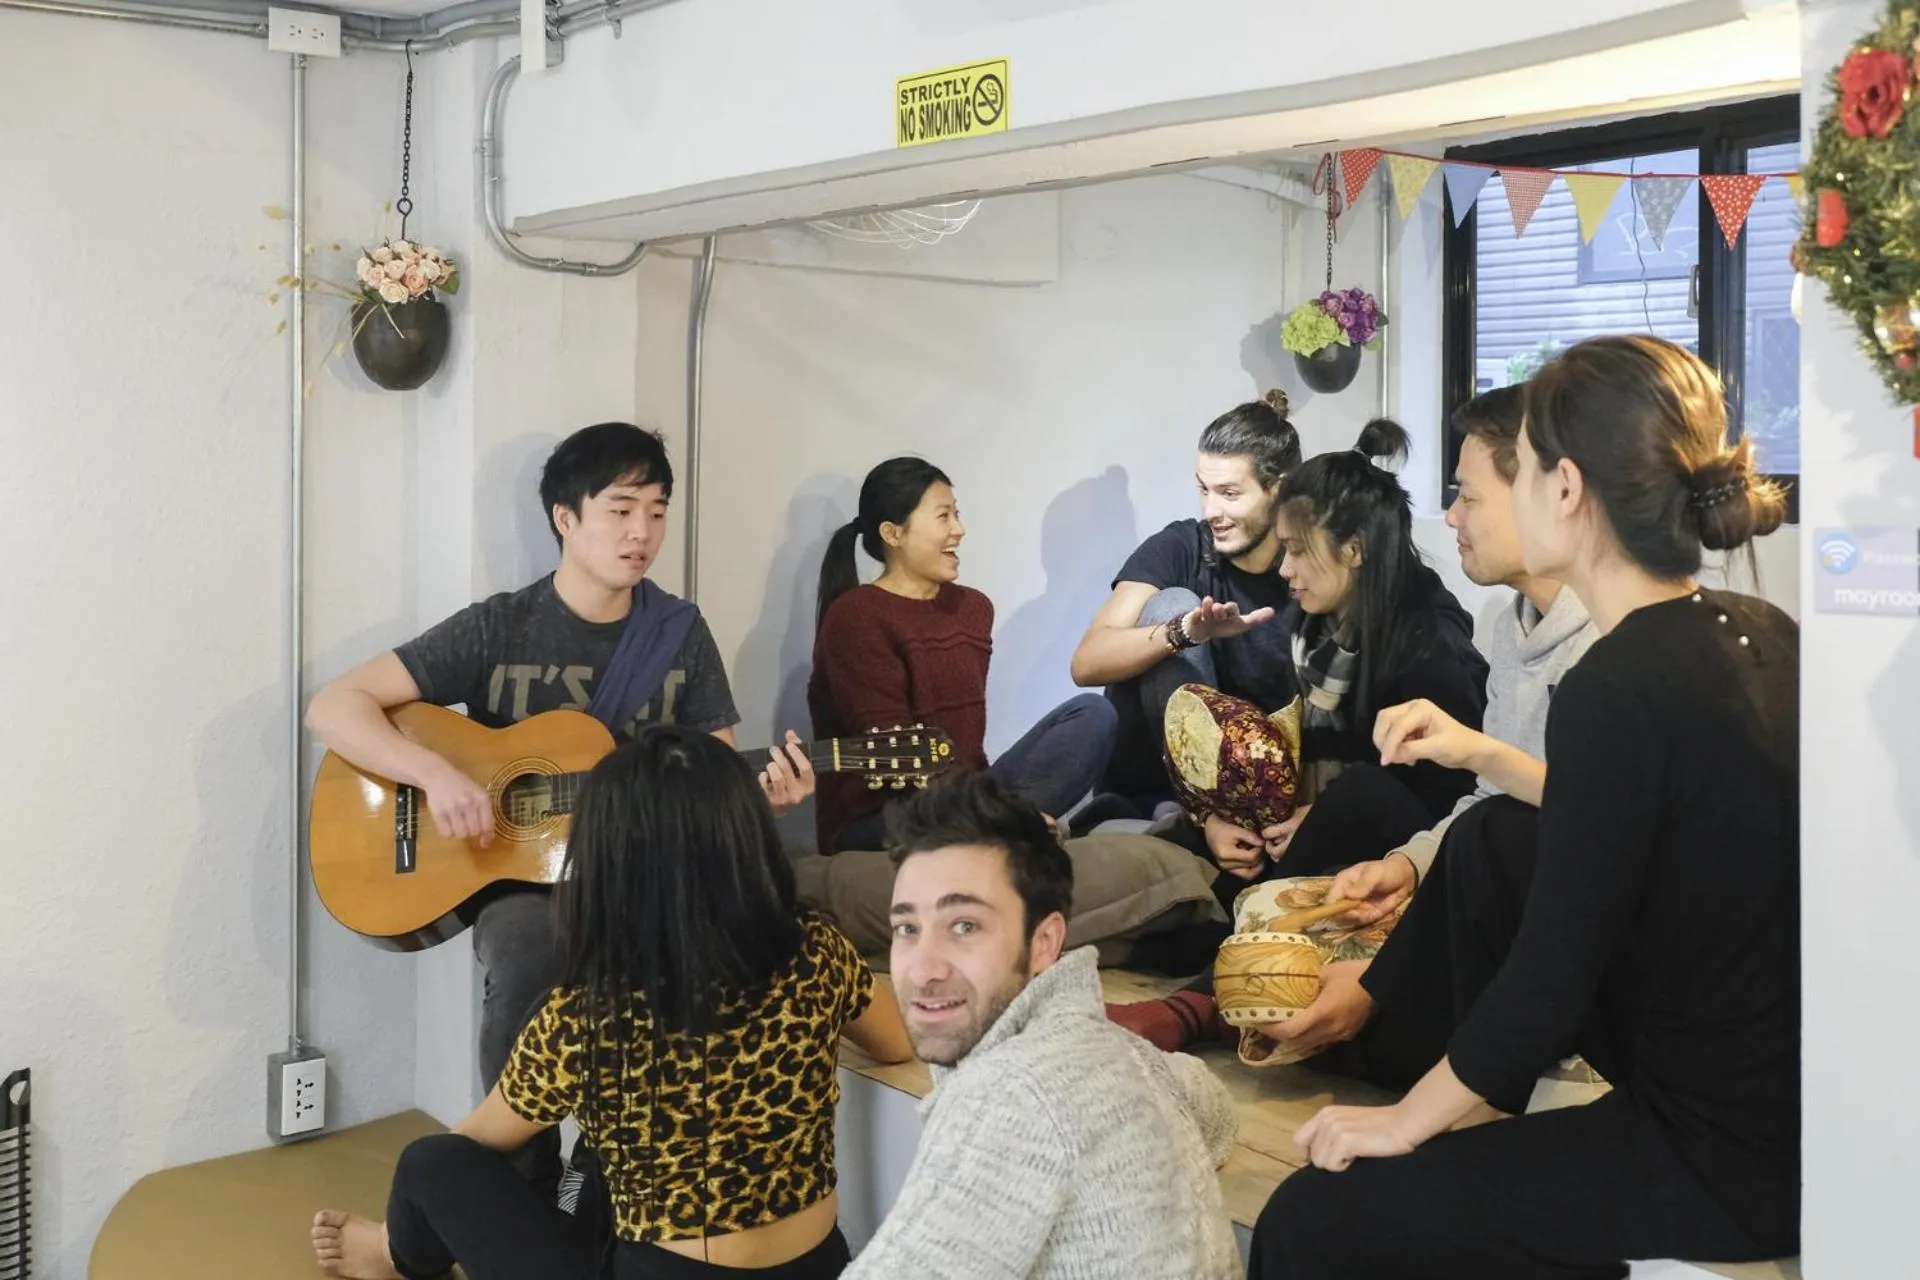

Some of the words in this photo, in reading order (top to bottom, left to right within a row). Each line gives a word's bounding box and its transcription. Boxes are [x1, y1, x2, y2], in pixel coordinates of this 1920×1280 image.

[900, 76, 971, 106] STRICTLY
[900, 106, 916, 142] NO
[918, 96, 971, 140] SMOKING
[1834, 588, 1920, 612] mayroo
[488, 663, 594, 722] IT'S
